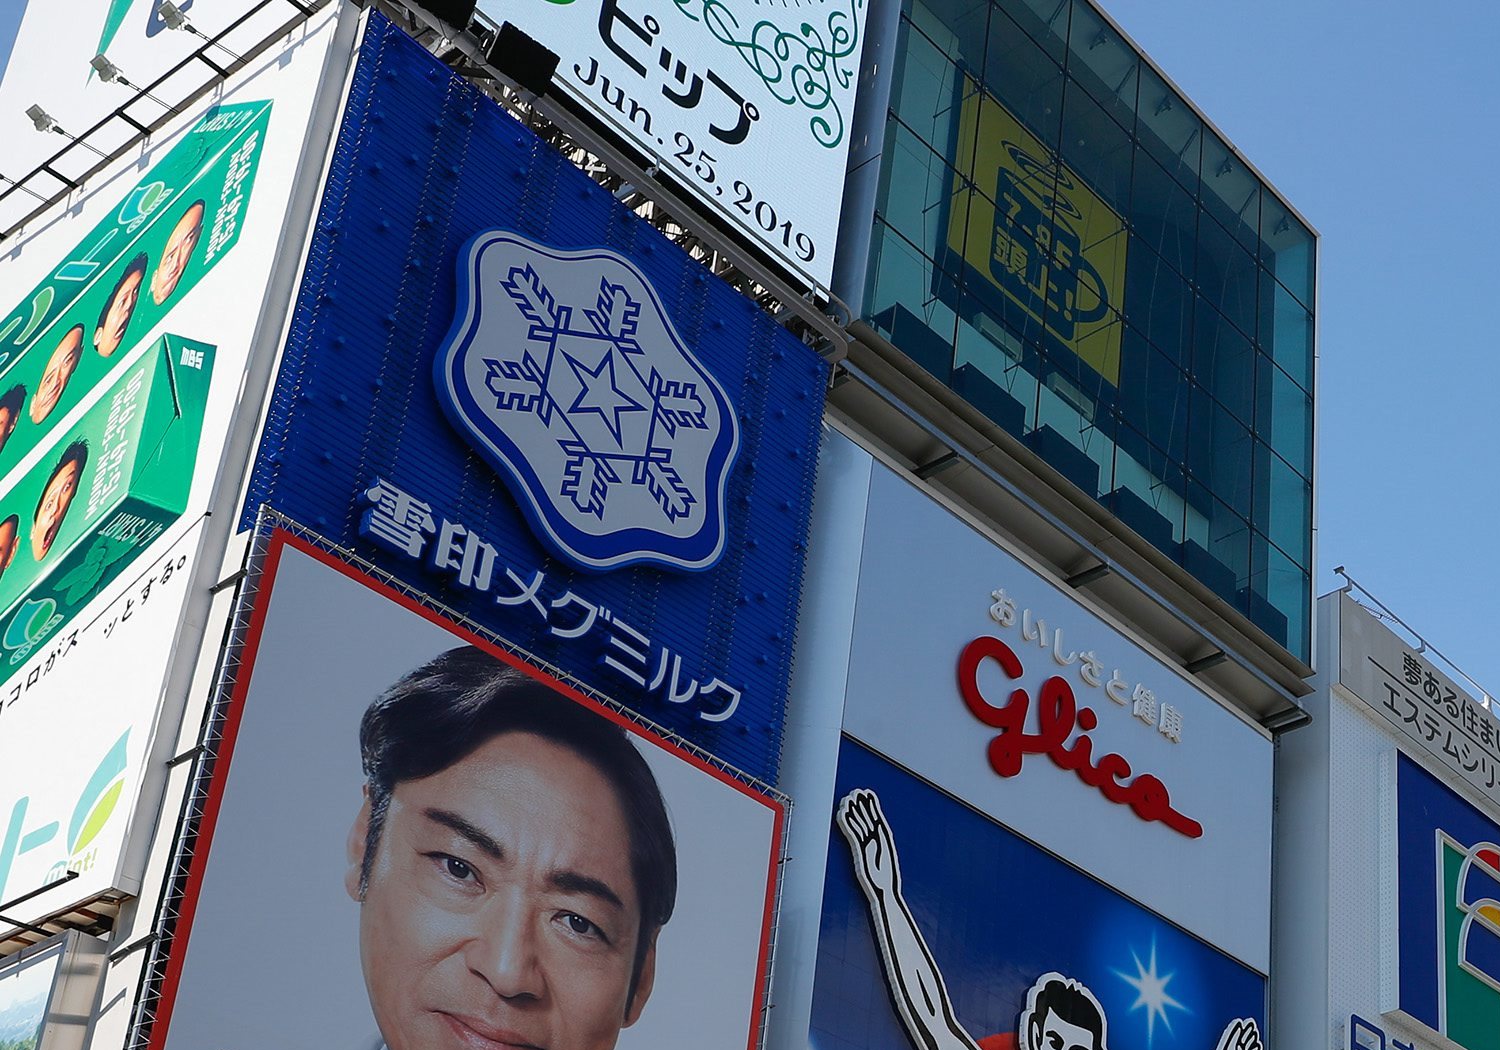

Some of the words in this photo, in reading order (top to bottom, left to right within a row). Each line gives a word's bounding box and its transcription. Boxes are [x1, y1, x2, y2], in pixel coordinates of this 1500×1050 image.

[572, 56, 664, 145] Jun.
[673, 131, 724, 197] 25,
[733, 183, 818, 263] 2019
[598, 0, 760, 145] ピップ
[0, 511, 210, 716] コロがスーッとする。
[364, 474, 742, 723] 雪印メグミルク
[988, 587, 1184, 744] おいしさと健康
[958, 635, 1204, 839] Glico
